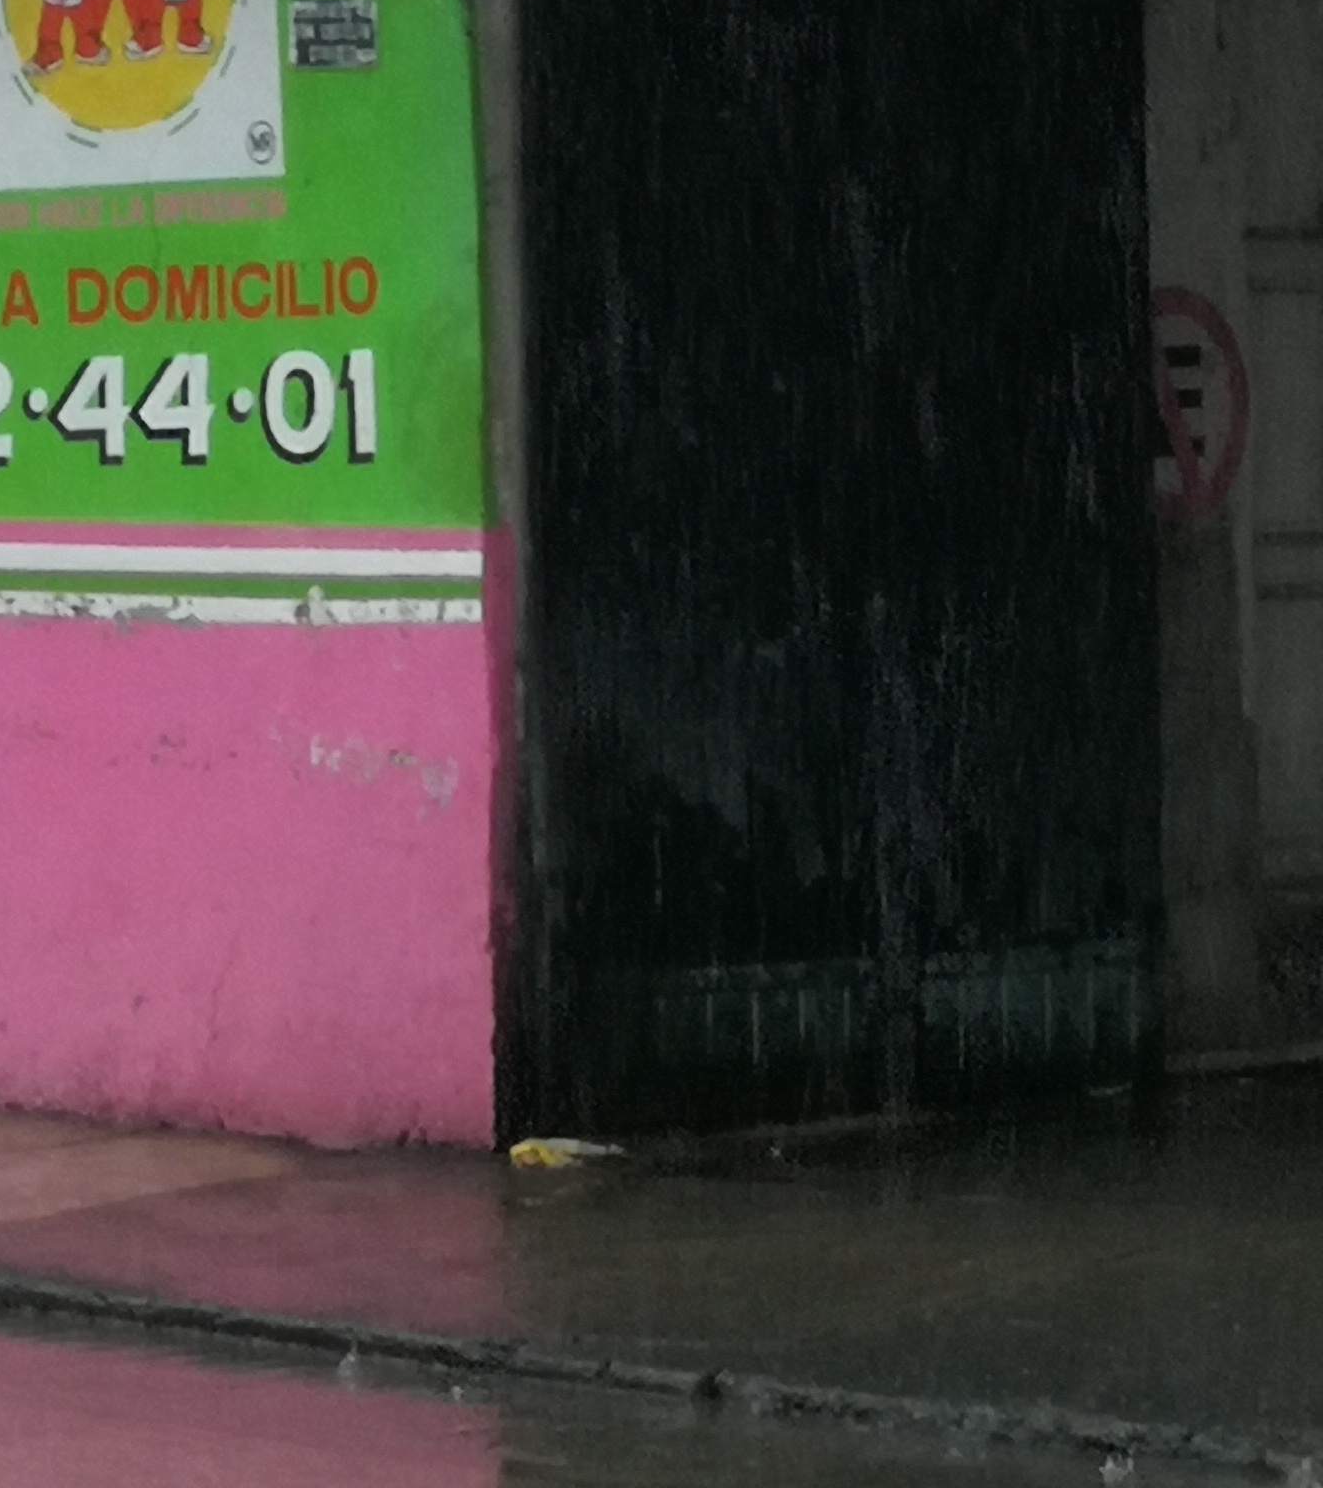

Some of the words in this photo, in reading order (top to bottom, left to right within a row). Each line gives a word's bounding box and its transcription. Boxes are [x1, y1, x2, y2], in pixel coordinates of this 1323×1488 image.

[110, 195, 145, 229] LA
[2, 269, 40, 328] A
[67, 255, 379, 326] DOMICILIO
